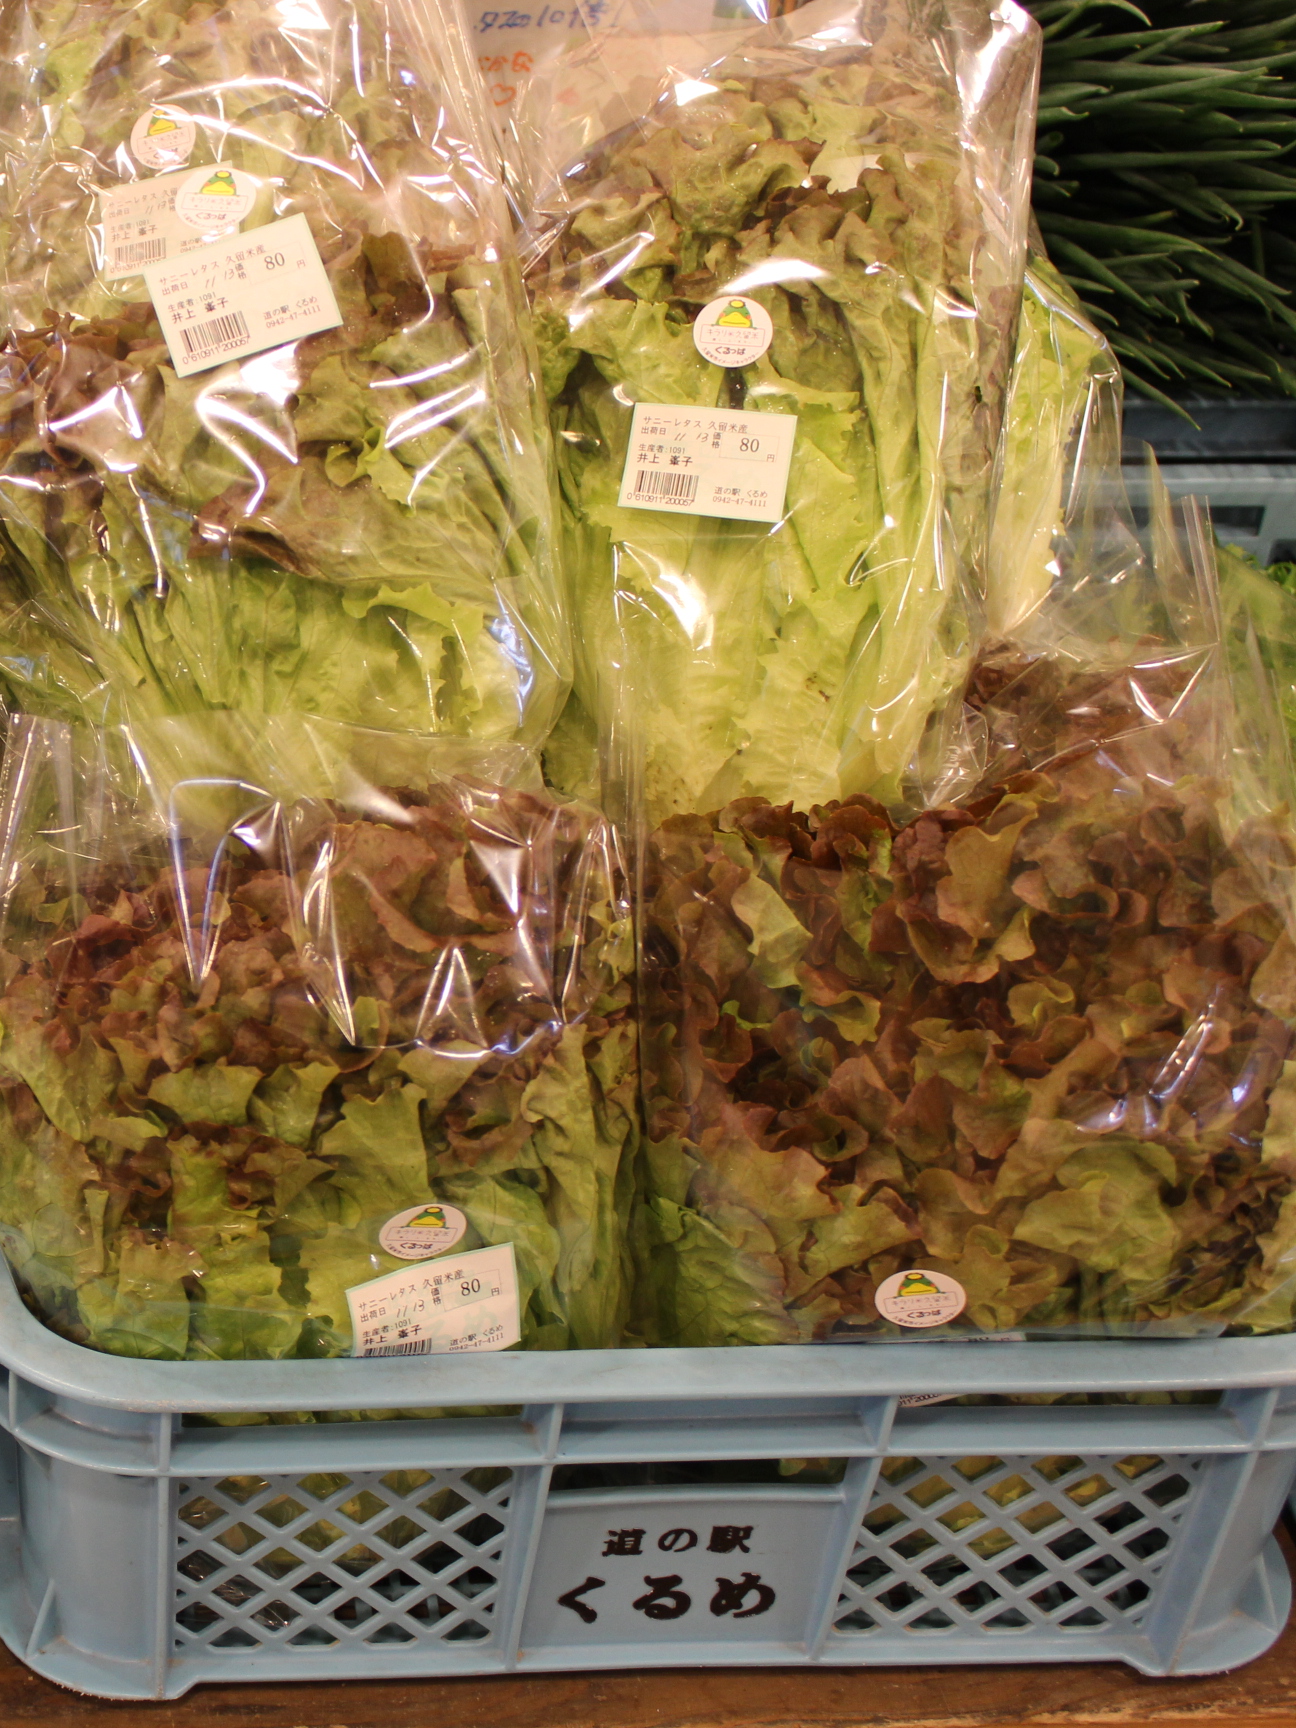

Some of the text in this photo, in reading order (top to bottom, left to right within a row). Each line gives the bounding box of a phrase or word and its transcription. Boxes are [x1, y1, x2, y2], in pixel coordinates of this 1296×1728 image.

[109, 188, 177, 208] サニーレタス 久留
[112, 231, 130, 242] 井上
[159, 262, 219, 285] サニーレタス
[226, 245, 266, 264] 久留米産
[264, 252, 306, 270] 80 円
[224, 269, 234, 280] 13
[162, 282, 189, 295] 出荷日
[171, 308, 196, 323] 井上
[263, 297, 317, 320] 道の駅 くるめ
[266, 305, 321, 329] 0942-47-4111
[183, 356, 188, 364] 0
[191, 345, 219, 361] 610911
[641, 426, 666, 435] 出荷日
[644, 416, 748, 433] サニーレタス 久留米産
[637, 453, 659, 464] 井上
[740, 438, 775, 462] 80 円
[635, 494, 662, 503] 610911
[715, 487, 768, 498] 道の駅 くるめ
[713, 496, 766, 507] 0942-47-4111
[359, 1269, 465, 1310] サニーレタス 久留米産
[461, 1278, 500, 1296] 80 円
[360, 1307, 386, 1322] 出荷日
[363, 1335, 387, 1346] 井上
[450, 1325, 503, 1346] 道の駅 くるめ
[602, 1525, 753, 1557] 道の駅
[558, 1572, 776, 1624] くるめ
